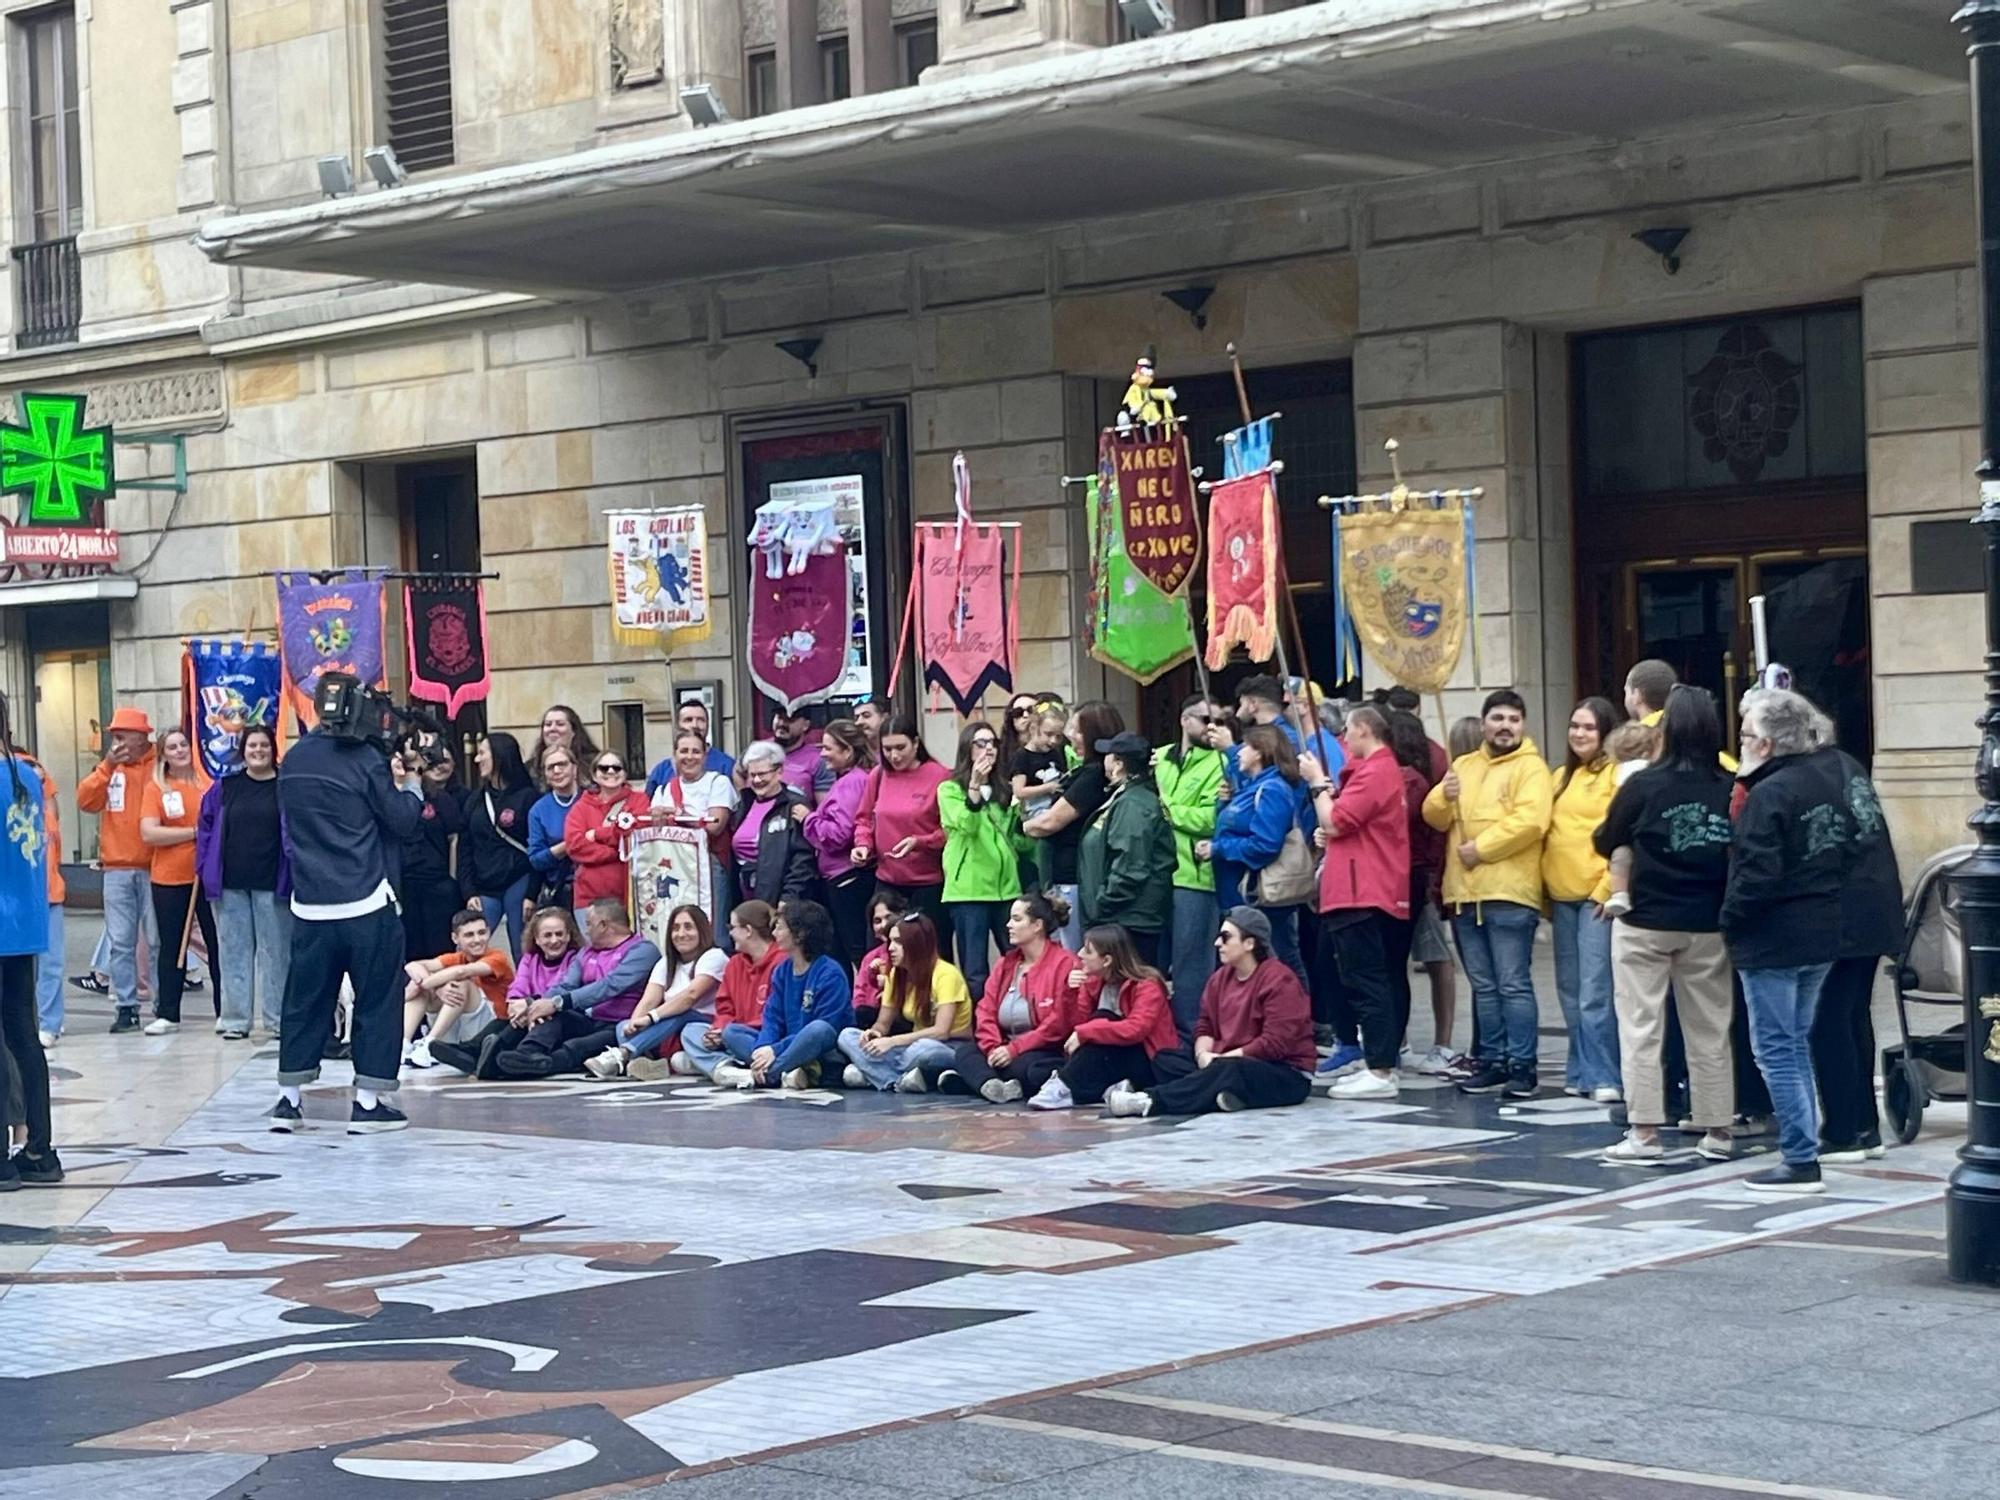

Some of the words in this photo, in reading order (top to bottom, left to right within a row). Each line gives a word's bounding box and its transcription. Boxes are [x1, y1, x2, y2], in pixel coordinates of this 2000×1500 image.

[616, 520, 635, 535] LOS
[7, 535, 59, 556] ABIERTO
[60, 532, 78, 560] 24
[78, 535, 117, 556] HORAS
